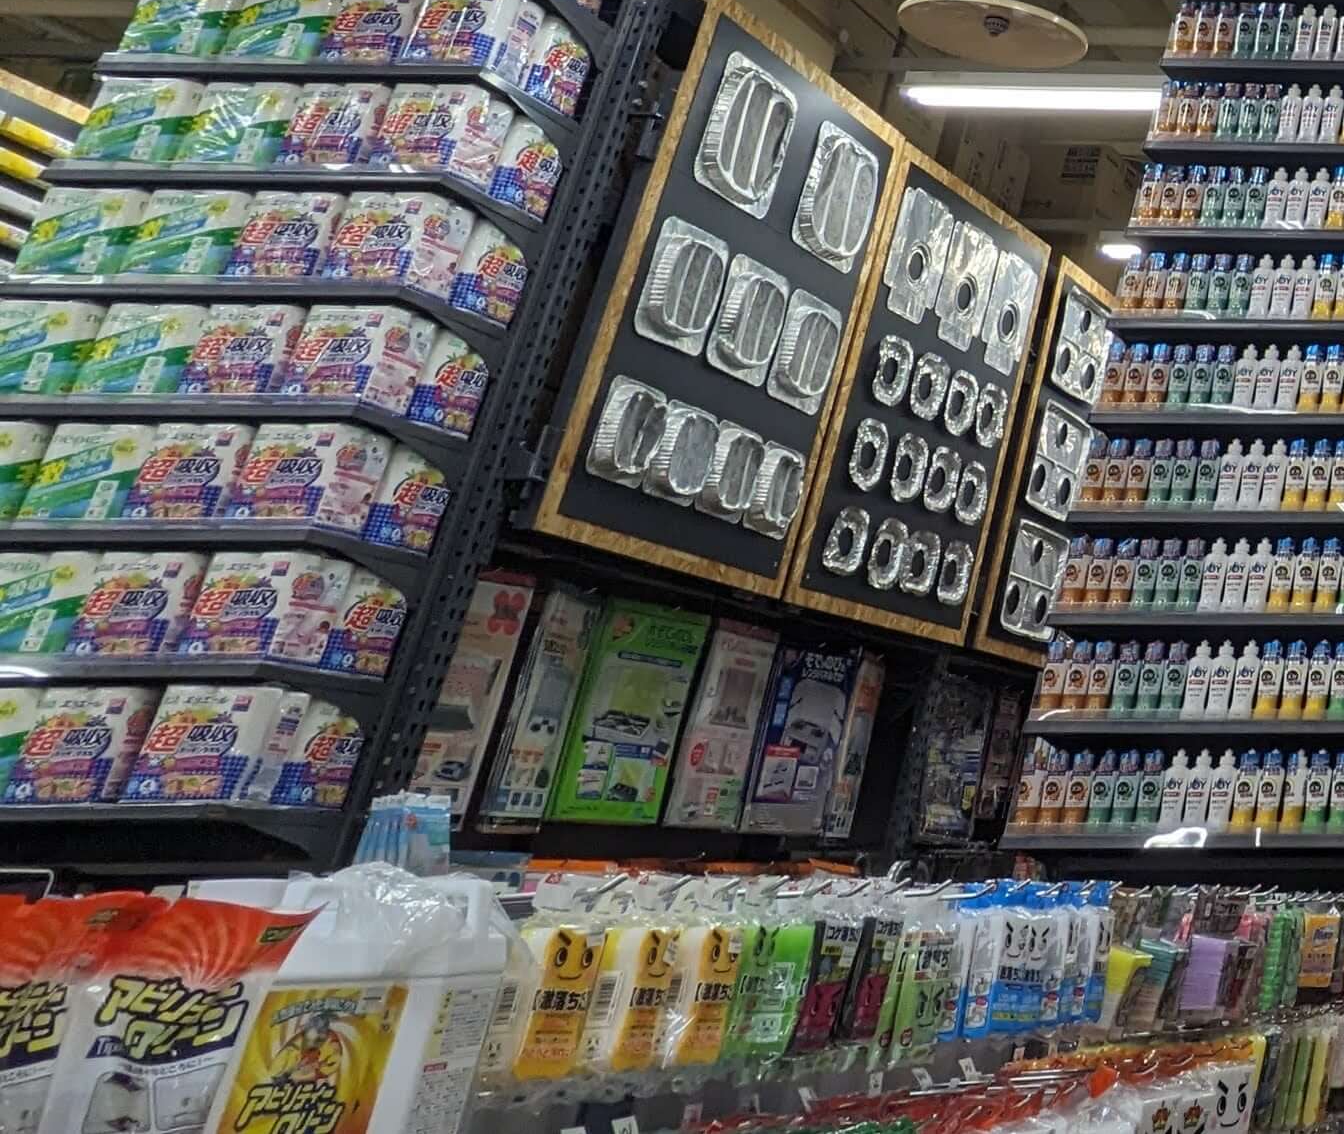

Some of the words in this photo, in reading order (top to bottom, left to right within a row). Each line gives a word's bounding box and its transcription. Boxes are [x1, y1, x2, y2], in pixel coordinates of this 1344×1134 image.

[138, 457, 219, 482] 超吸収
[239, 457, 323, 482] 超吸収
[83, 588, 167, 616] 超吸収
[191, 588, 277, 616] 超吸収
[25, 727, 111, 757] 超吸収
[146, 724, 238, 754] 超吸収
[235, 1082, 338, 1132] アビリティー
